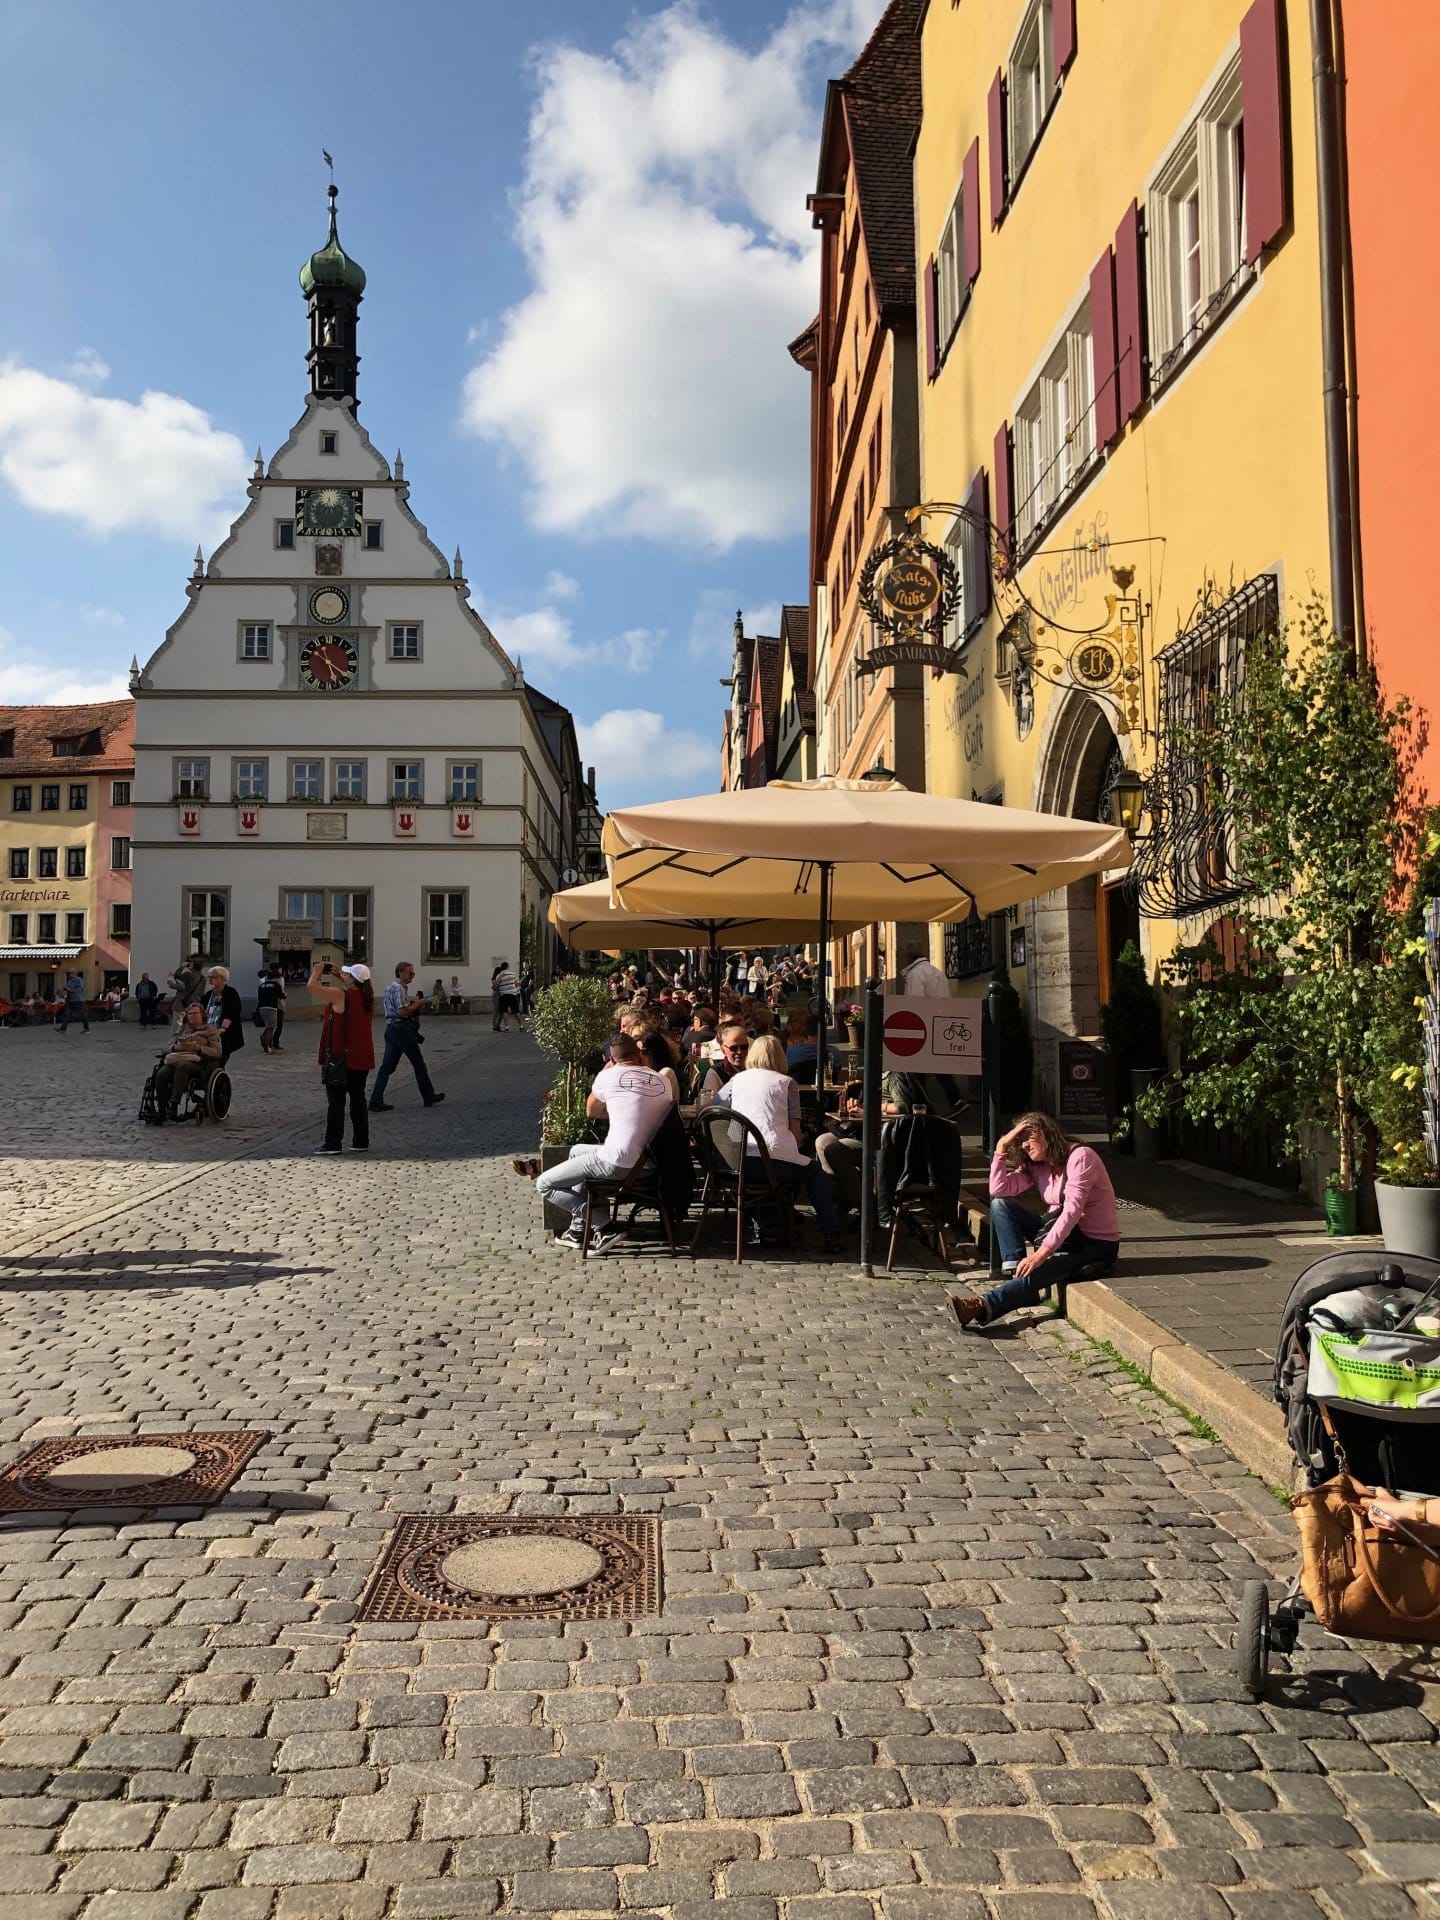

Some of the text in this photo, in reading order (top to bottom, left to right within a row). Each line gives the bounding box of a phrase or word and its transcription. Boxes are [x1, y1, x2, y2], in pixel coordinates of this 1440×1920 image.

[873, 646, 951, 665] RESTAURANT
[280, 937, 303, 945] KASSE
[949, 1043, 966, 1052] frei
